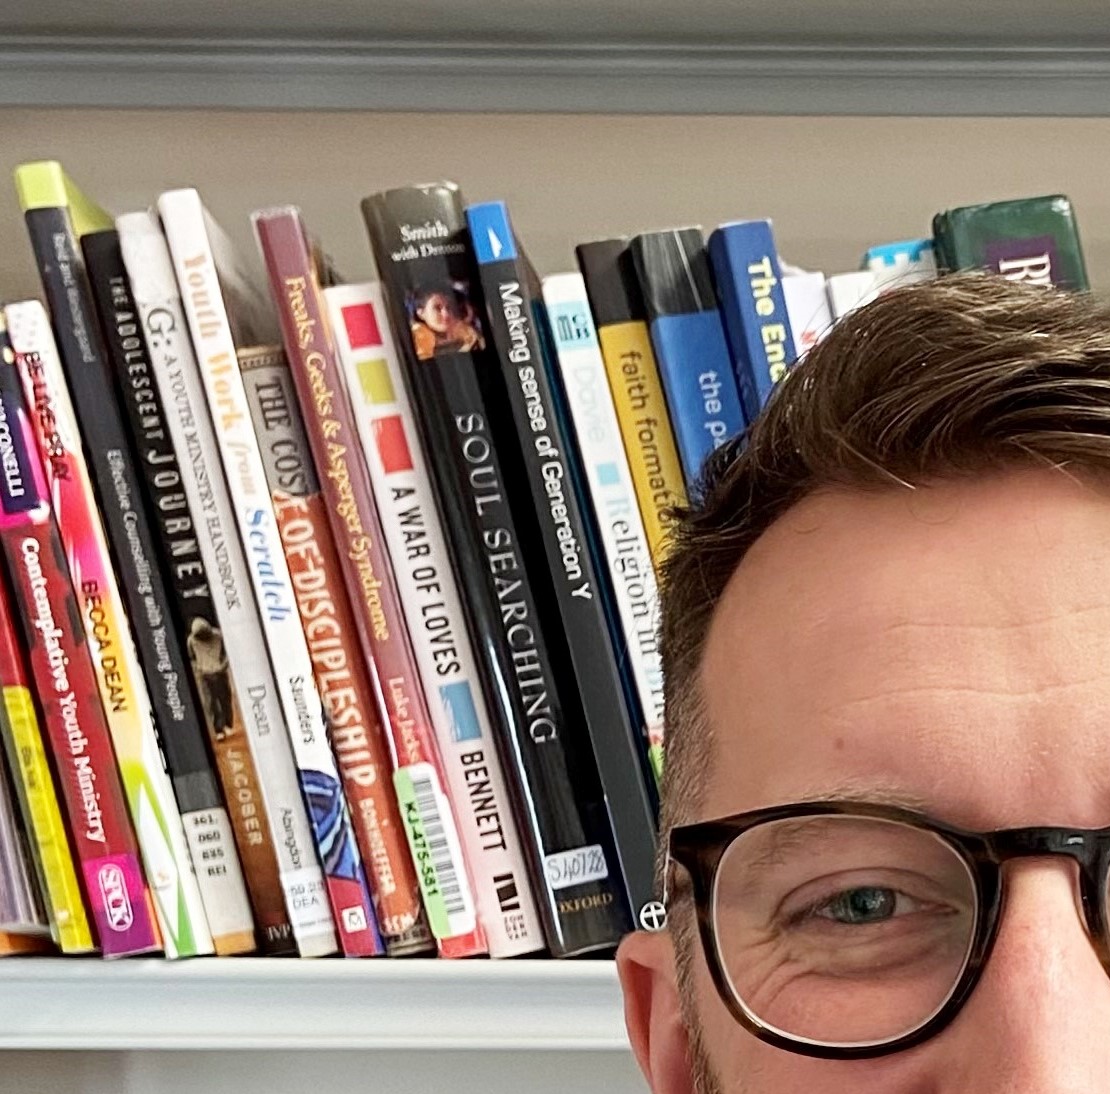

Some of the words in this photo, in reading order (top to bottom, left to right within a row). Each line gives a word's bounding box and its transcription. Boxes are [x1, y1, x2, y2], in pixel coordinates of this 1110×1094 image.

[400, 219, 449, 244] Smith
[746, 255, 779, 318] The
[500, 281, 531, 363] Making
[255, 374, 284, 432] THE
[306, 352, 335, 418] Geeks
[518, 365, 547, 432] sense
[620, 350, 650, 412] faith
[699, 369, 722, 415] the
[115, 310, 163, 442] ADOLESCENT
[146, 449, 209, 599] JOURNEY
[182, 253, 219, 341] Youth
[206, 351, 242, 433] Work
[246, 508, 292, 622] Scratch
[321, 418, 342, 438] &
[534, 434, 559, 459] of
[168, 370, 197, 426] YOUTH
[185, 428, 219, 508] MINISTRY
[203, 511, 241, 612] HANDBOOK
[326, 440, 363, 534] Asperger
[391, 486, 415, 502] A
[397, 508, 431, 561] WAR
[541, 460, 583, 584] Generation
[349, 535, 390, 641] Syndrome
[412, 566, 442, 599] OF
[455, 413, 499, 517] SOUL
[482, 529, 558, 747] SEARCHING
[571, 581, 594, 602] Y
[605, 500, 647, 626] Religion
[21, 537, 70, 693] Contemplative
[420, 602, 461, 678] LOVES
[152, 628, 174, 673] Young
[99, 654, 129, 713] DEAN
[162, 672, 185, 721] People
[247, 684, 272, 737] Dean
[60, 691, 90, 756] Youth
[71, 755, 107, 845] Ministry
[227, 747, 262, 847] JACOBER
[460, 749, 507, 853] BENNETT
